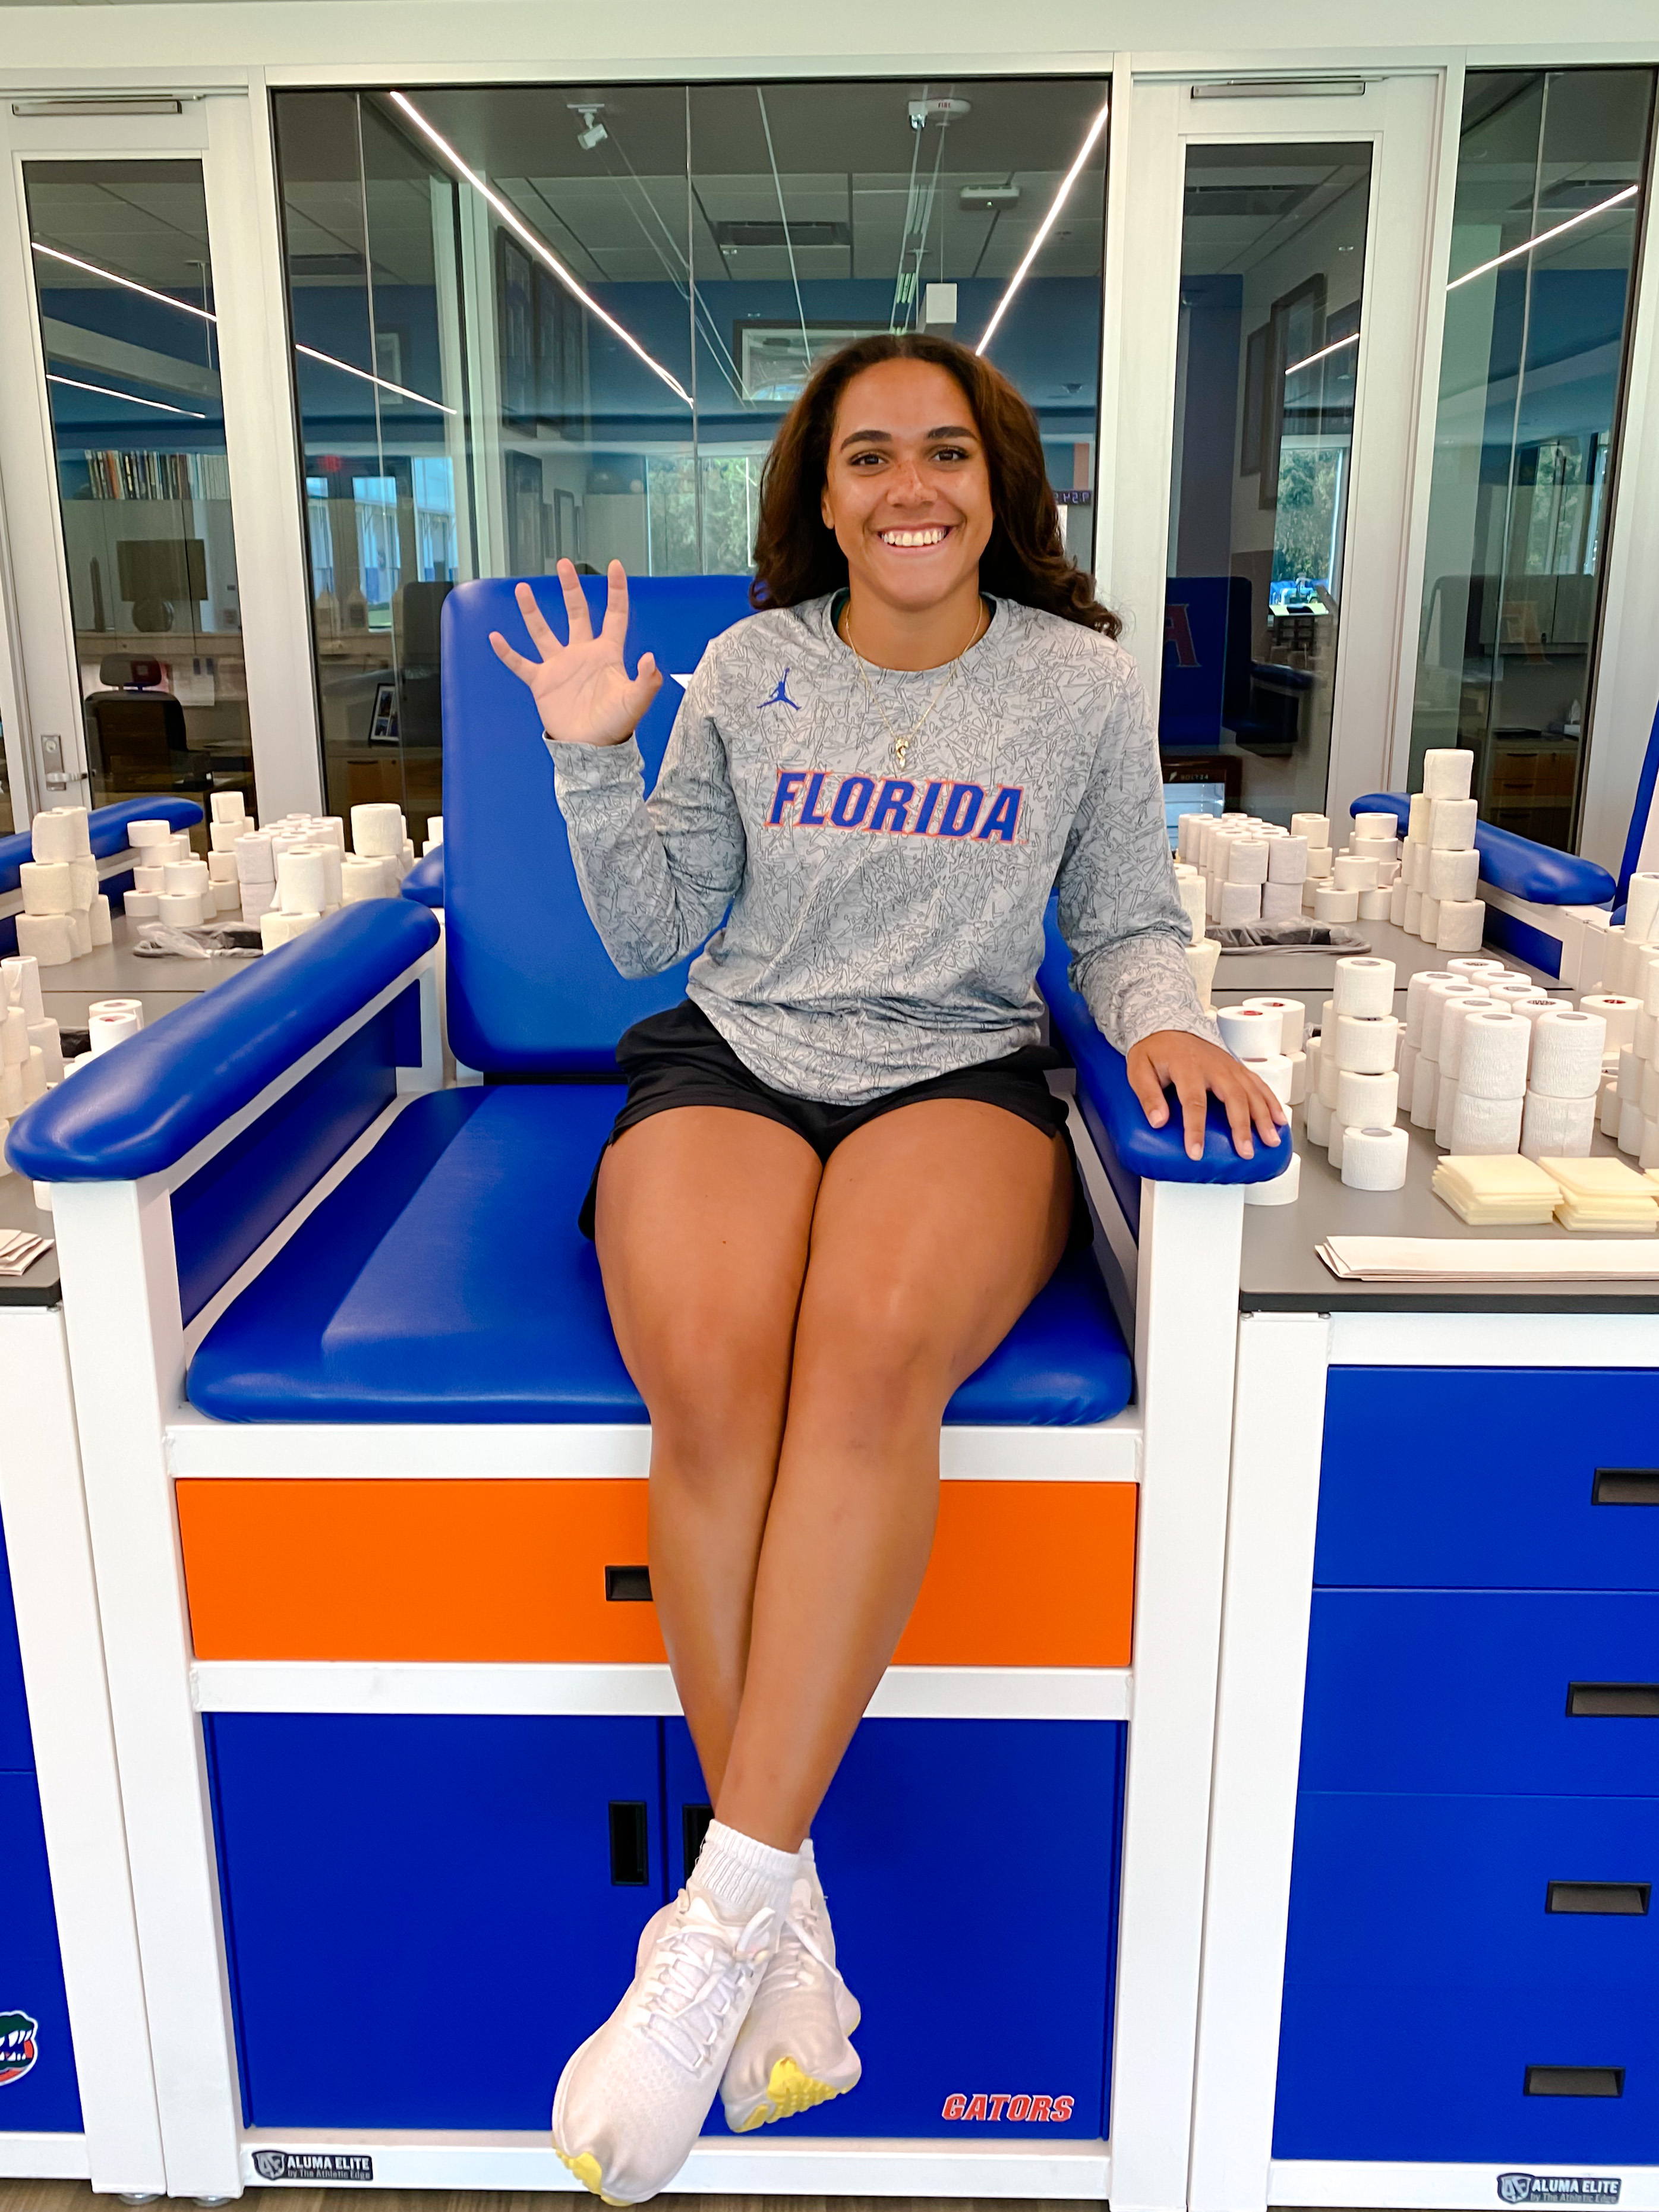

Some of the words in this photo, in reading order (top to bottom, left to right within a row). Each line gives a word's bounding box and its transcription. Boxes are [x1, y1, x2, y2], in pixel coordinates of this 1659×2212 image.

[764, 770, 1023, 844] FLORIDA
[942, 2093, 1074, 2122] GATORS
[288, 2156, 332, 2170] ALUMA
[335, 2157, 370, 2170] ELITE
[300, 2169, 314, 2178] The
[1532, 2179, 1578, 2193] ALUMA
[1582, 2180, 1619, 2194] ELITE
